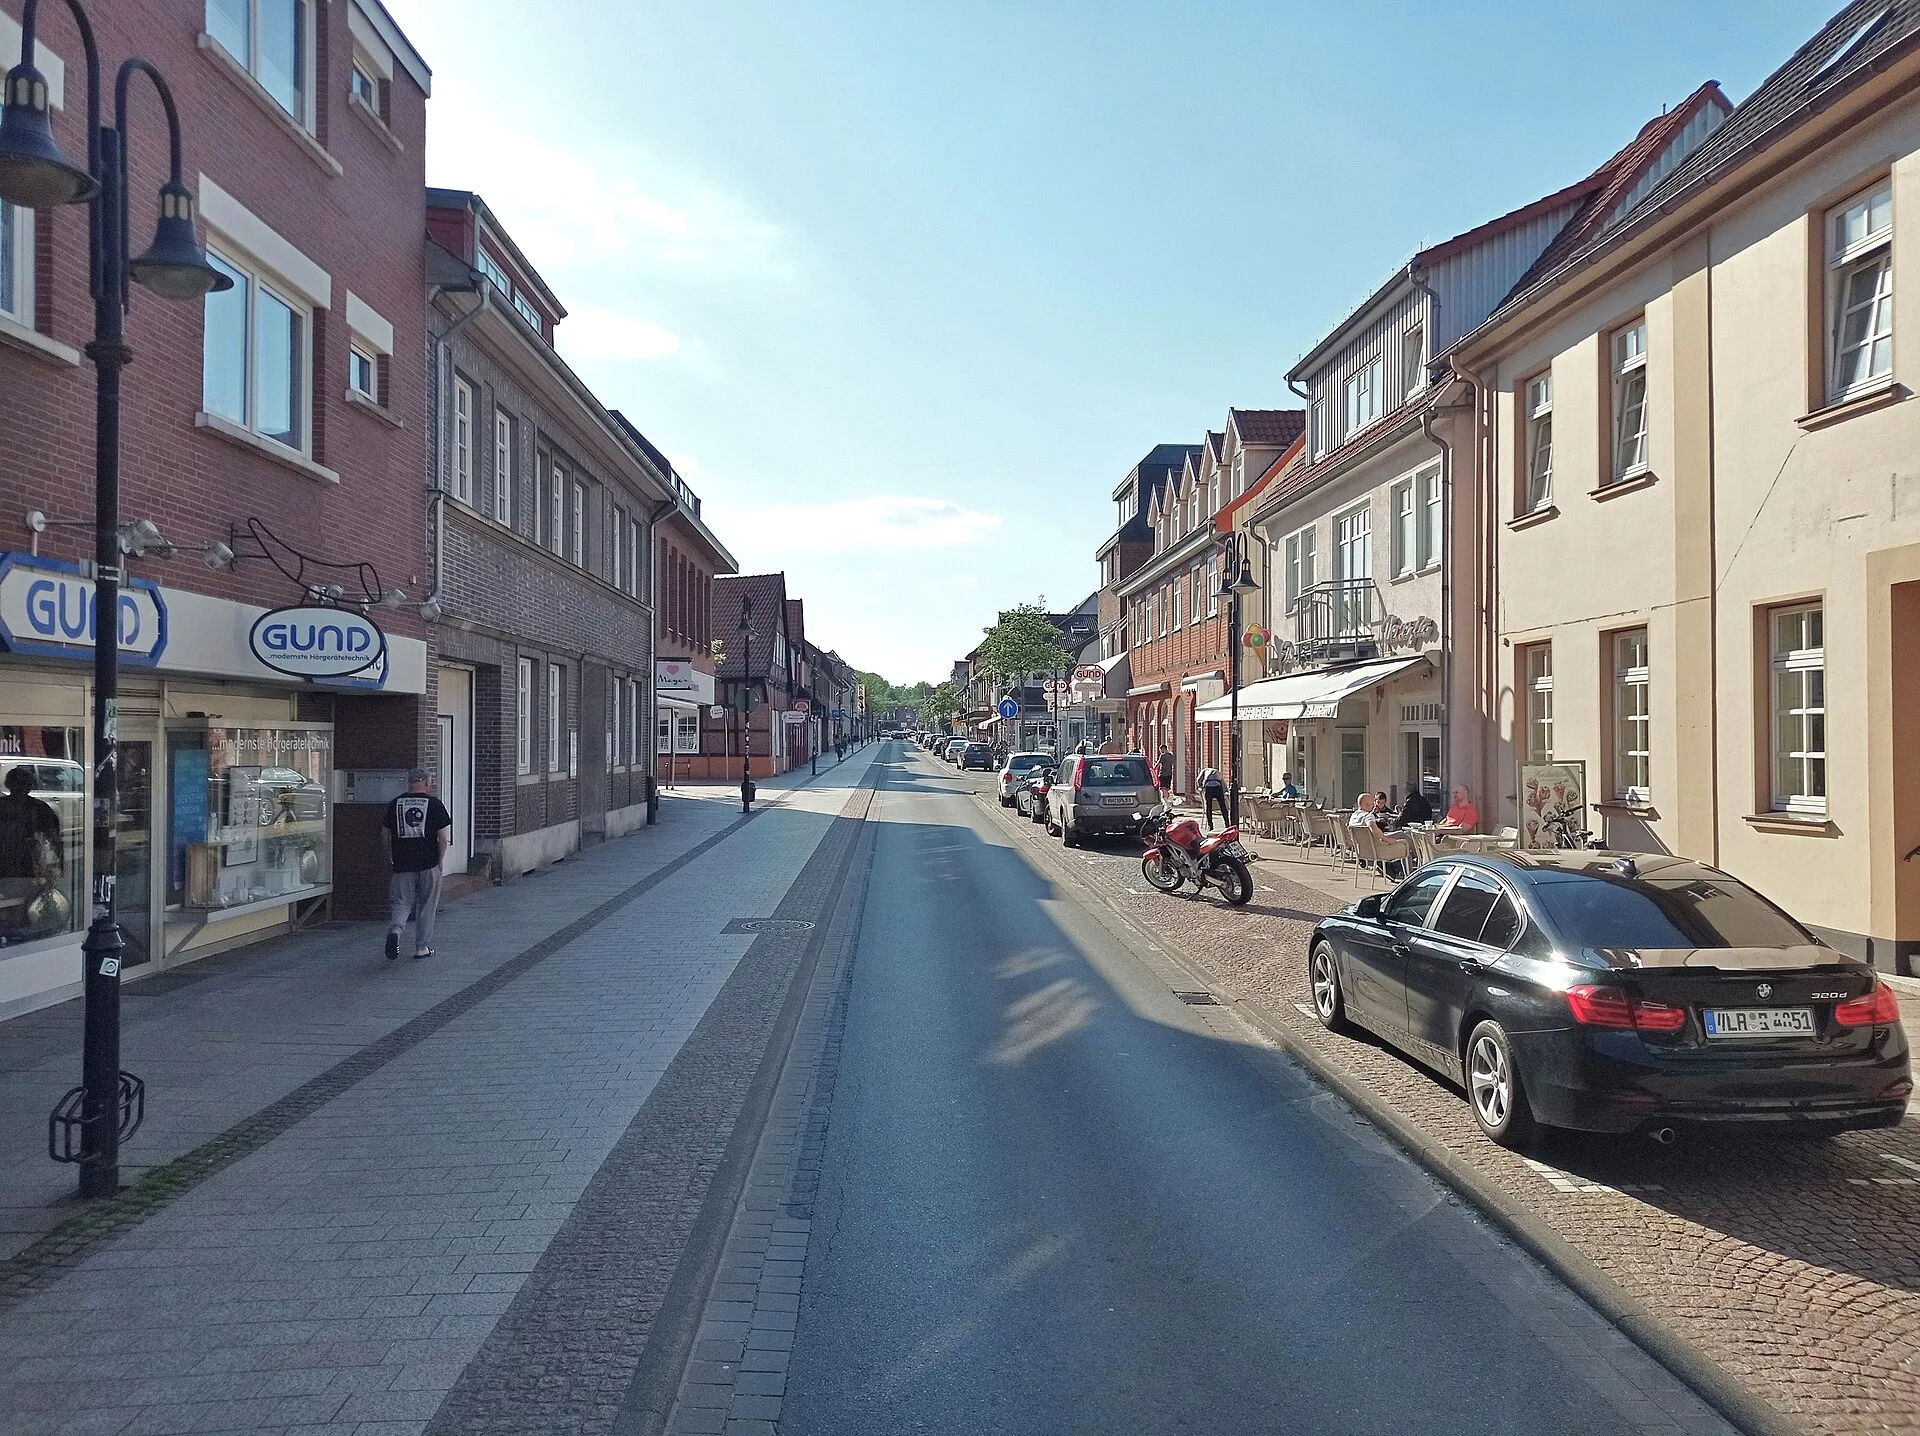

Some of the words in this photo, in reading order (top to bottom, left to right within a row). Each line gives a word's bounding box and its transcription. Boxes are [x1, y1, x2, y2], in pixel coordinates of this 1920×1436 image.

[26, 580, 140, 646] GUD
[262, 624, 371, 652] GUND
[309, 653, 371, 662] Hörgerätetechnik
[1076, 670, 1102, 679] GUND
[1811, 991, 1848, 999] 320d
